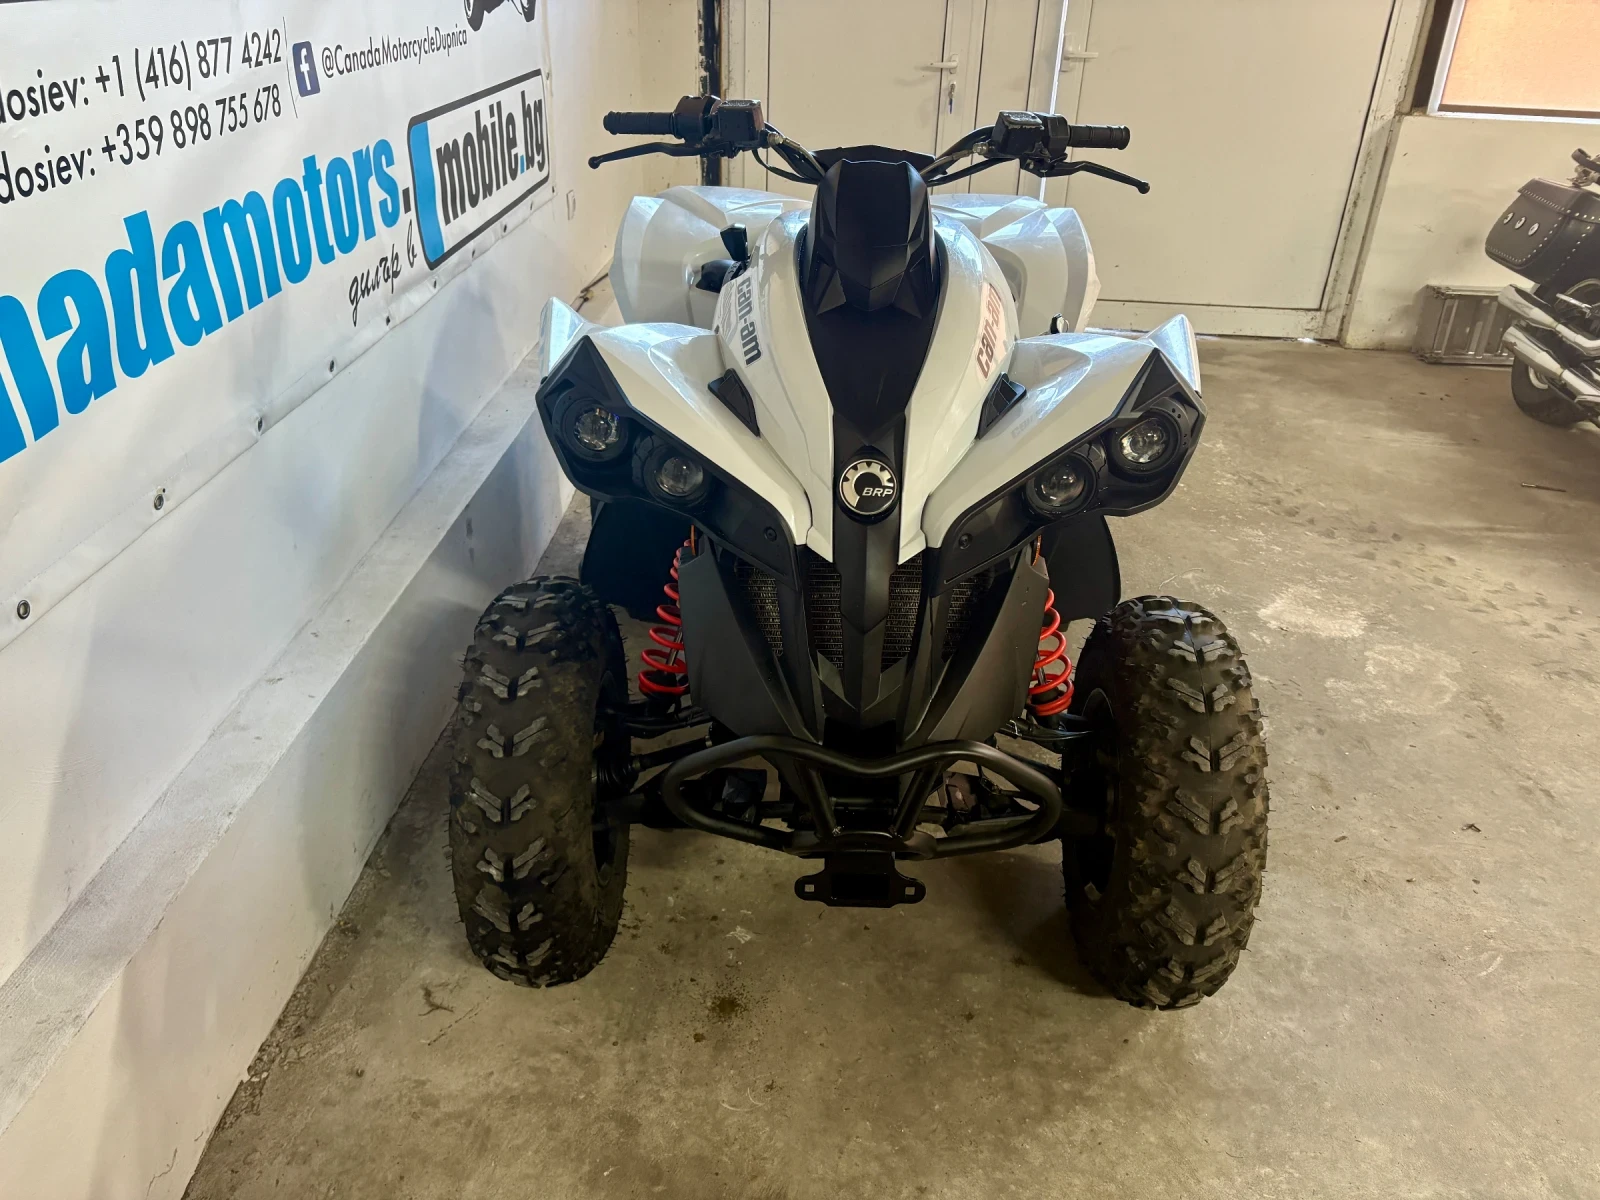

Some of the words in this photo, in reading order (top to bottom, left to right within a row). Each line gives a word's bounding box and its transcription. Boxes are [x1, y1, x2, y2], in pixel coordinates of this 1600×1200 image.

[95, 55, 124, 97] +1
[135, 40, 191, 102] (416)
[196, 36, 233, 79] 877
[241, 28, 282, 69] 4242
[322, 26, 468, 79] @CanadaMotorcycleDupnica
[101, 115, 163, 165] +359
[170, 103, 212, 149] 898
[215, 92, 248, 136] 755
[254, 83, 281, 123] 678
[436, 89, 545, 226] mobile.bg
[349, 243, 402, 327] дилър
[737, 276, 762, 366] can-am
[976, 286, 1001, 379] can-am
[862, 487, 893, 498] BRP
